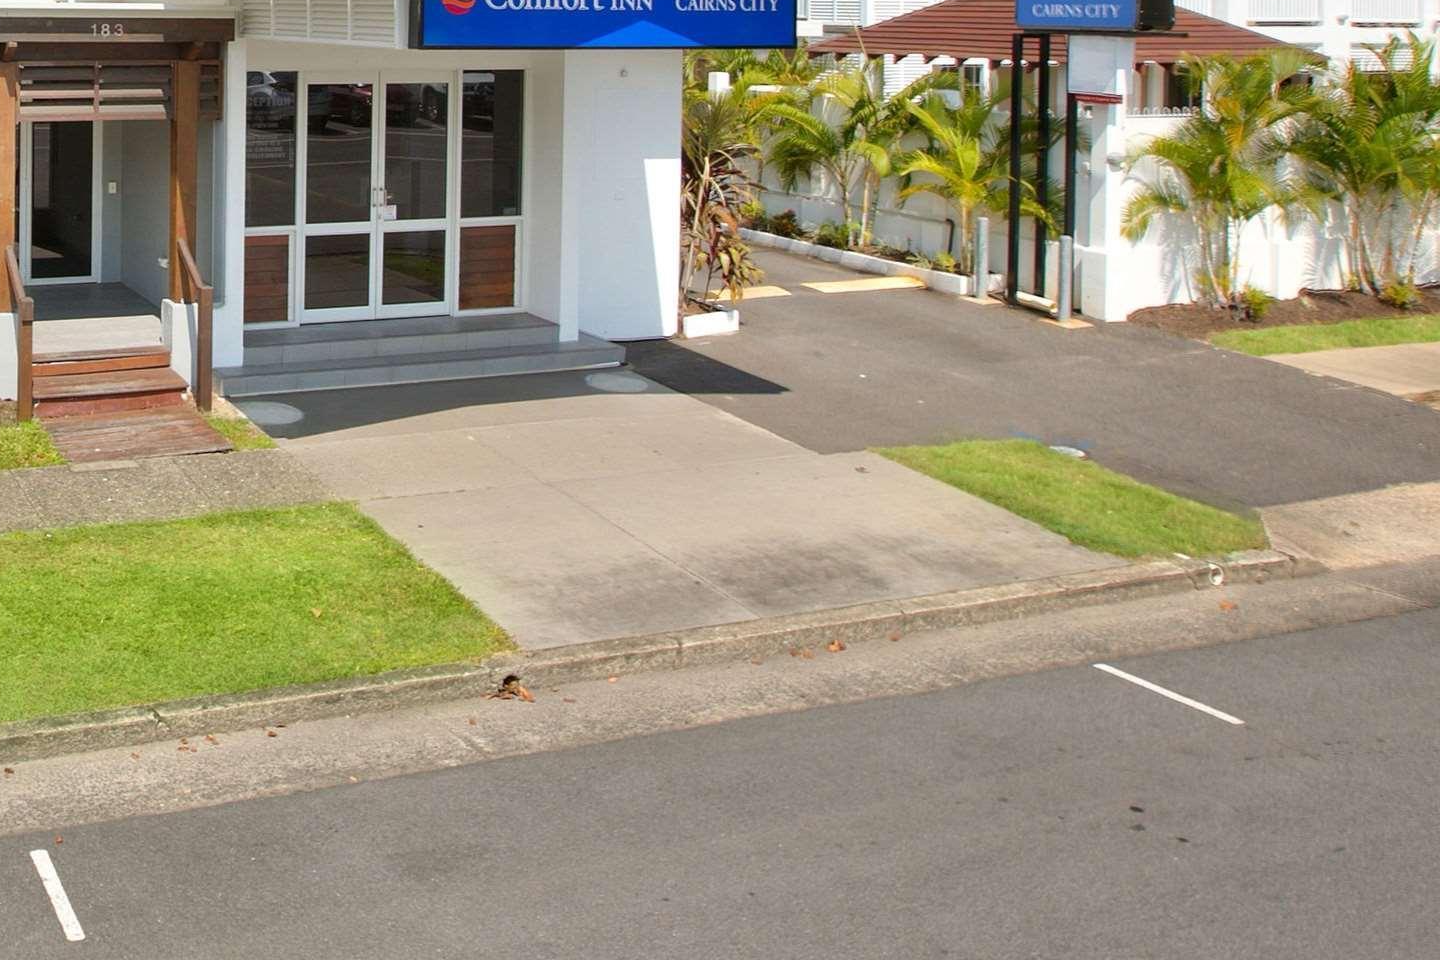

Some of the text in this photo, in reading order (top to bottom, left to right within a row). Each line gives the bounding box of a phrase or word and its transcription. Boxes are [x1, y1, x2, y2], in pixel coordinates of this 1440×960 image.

[1032, 3, 1121, 18] CAIRNS CITY
[91, 23, 124, 37] 183
